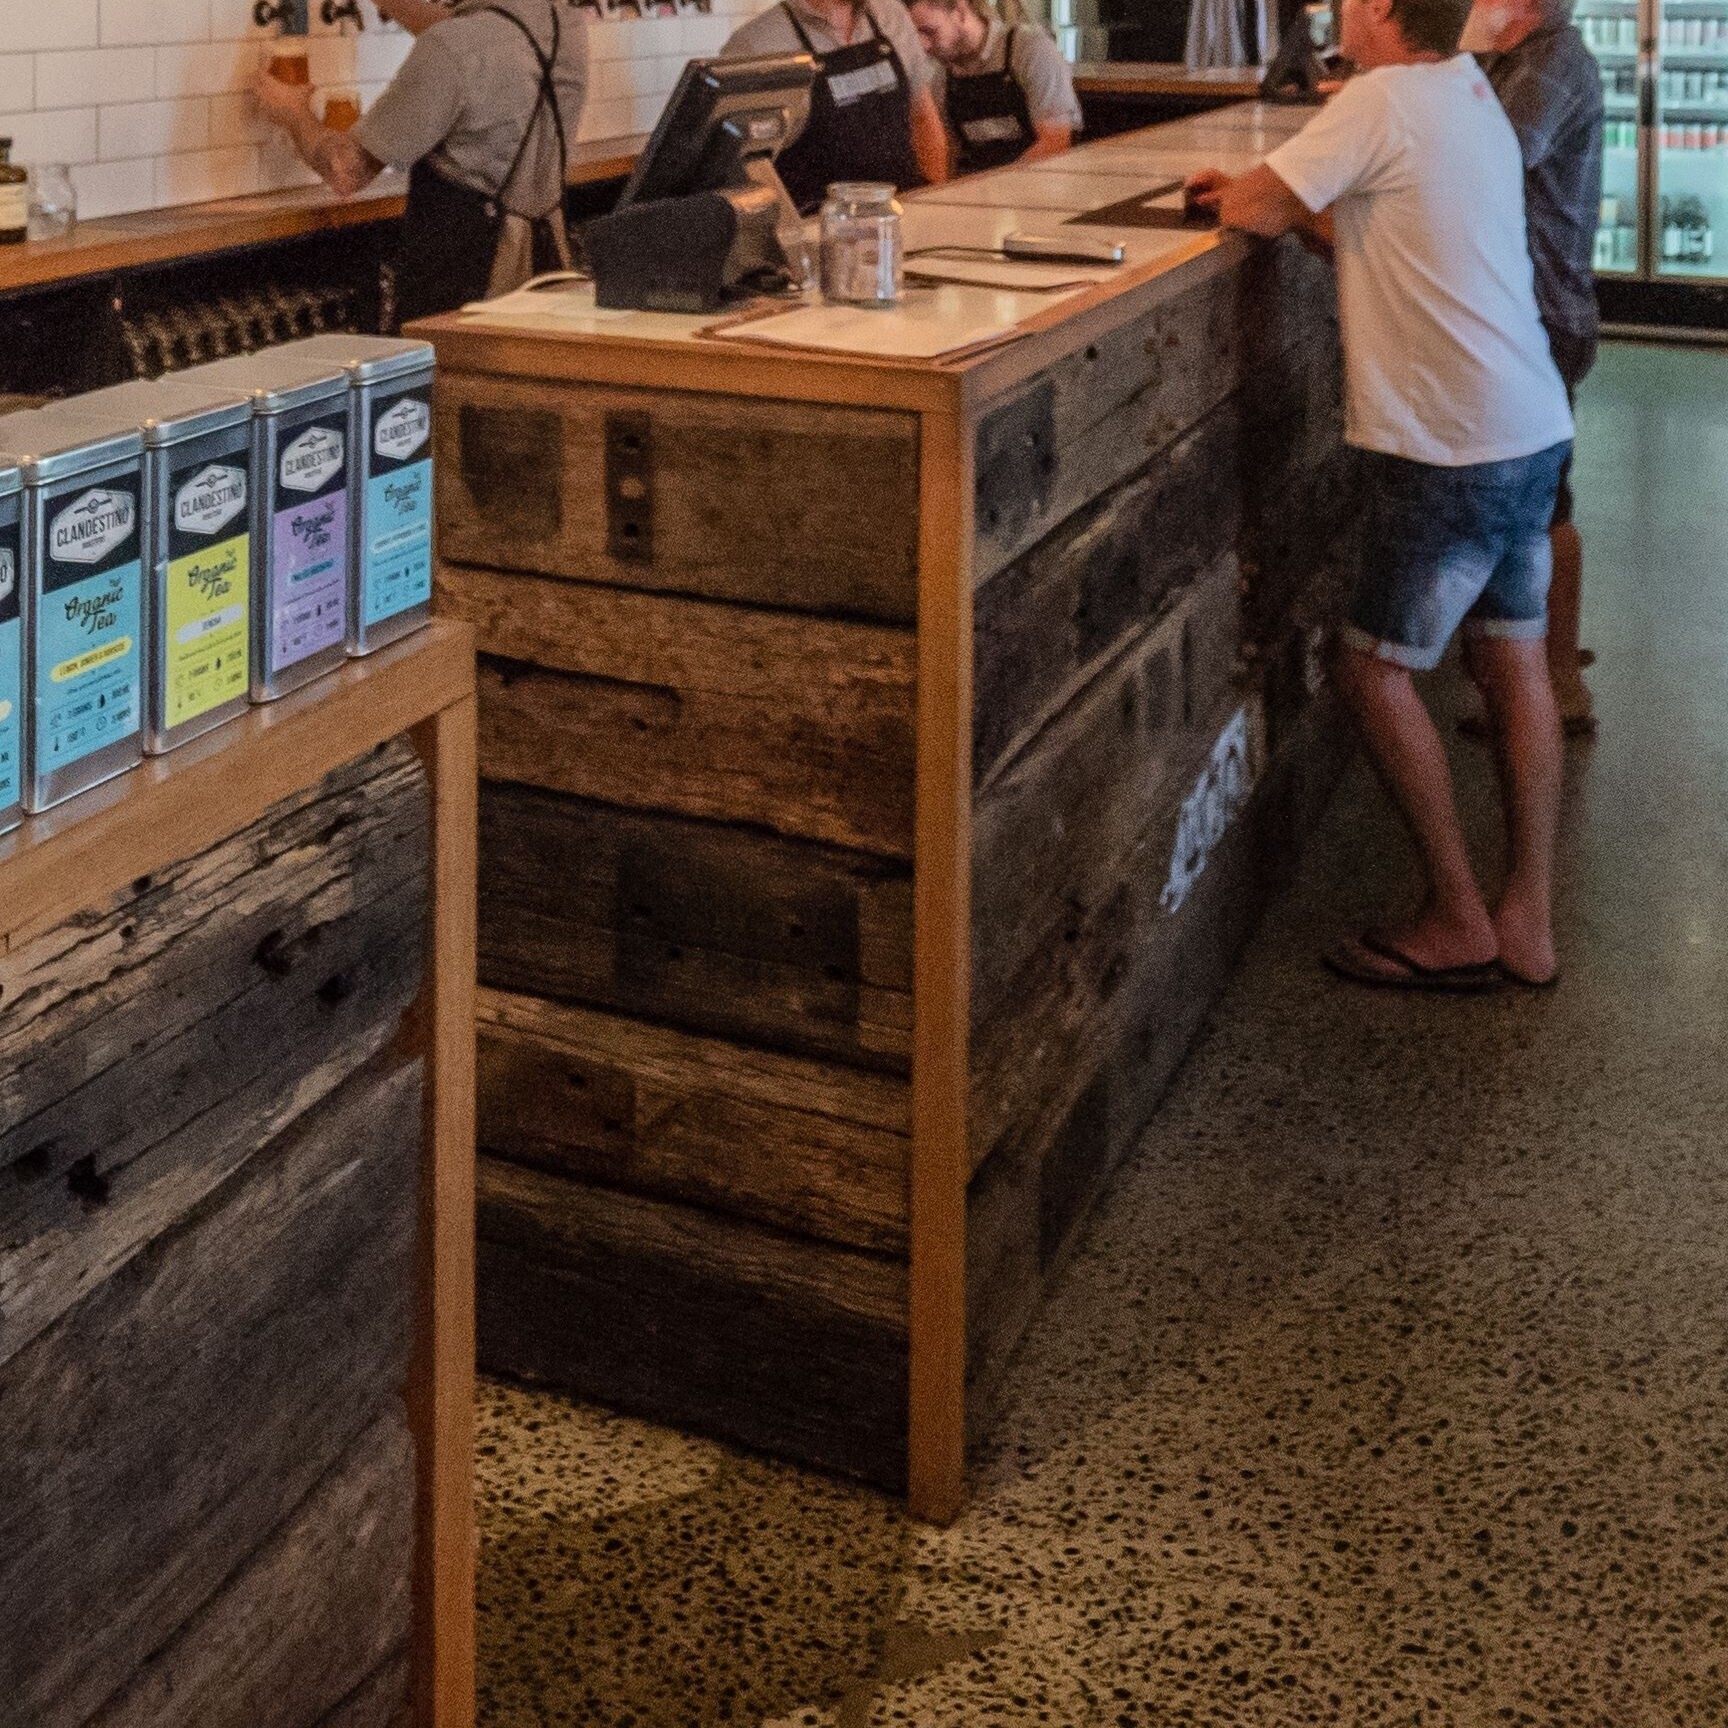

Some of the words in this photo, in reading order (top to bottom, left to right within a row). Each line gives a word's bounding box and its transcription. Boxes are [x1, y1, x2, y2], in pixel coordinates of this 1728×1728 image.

[56, 506, 130, 547] CLANDESTINO
[64, 587, 124, 628] Organic
[87, 608, 117, 635] Tea
